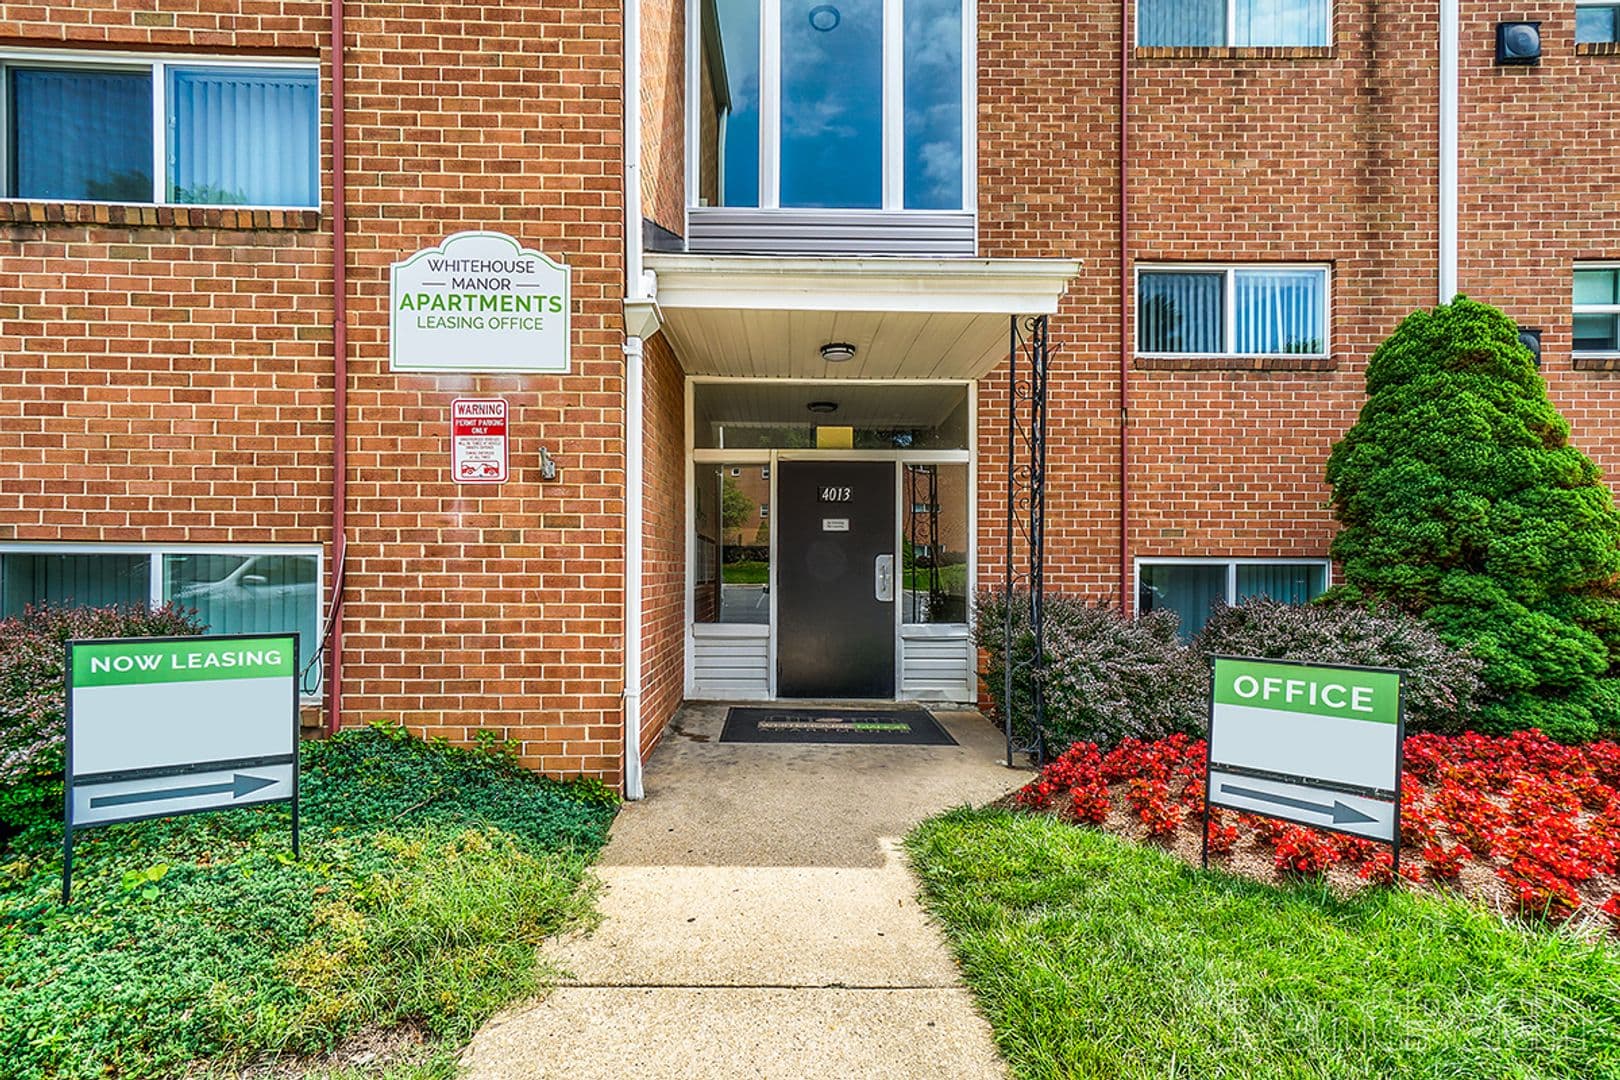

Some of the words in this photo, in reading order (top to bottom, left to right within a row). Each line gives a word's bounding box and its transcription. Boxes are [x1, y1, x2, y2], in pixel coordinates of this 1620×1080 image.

[427, 259, 535, 274] WHITEHOUSE
[452, 277, 511, 291] MANOR
[399, 293, 562, 313] APARTMENTS
[417, 316, 484, 330] LEASING
[488, 316, 543, 330] OFFICE
[457, 404, 502, 415] WARNING
[478, 419, 504, 427] PARKING
[822, 487, 850, 501] 4013
[91, 654, 163, 673] NOW
[171, 650, 281, 670] LEASING
[1233, 675, 1374, 713] OFFICE
